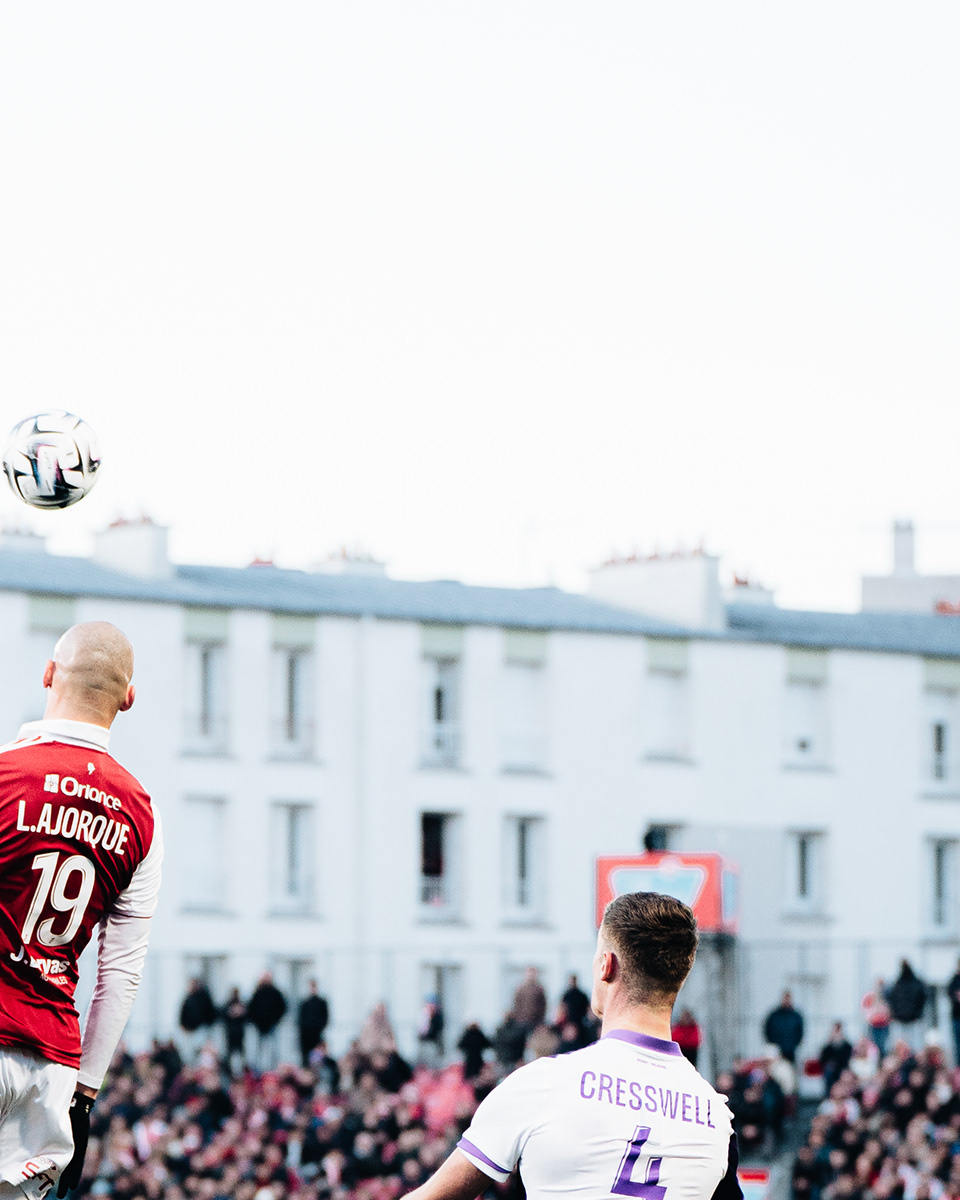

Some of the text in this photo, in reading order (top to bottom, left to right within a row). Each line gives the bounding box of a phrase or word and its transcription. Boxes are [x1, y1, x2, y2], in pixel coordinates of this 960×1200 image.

[60, 776, 122, 811] Oriance
[16, 800, 130, 855] L.AJORQUE
[21, 851, 96, 947] 19
[580, 1070, 716, 1129] CRESSWELL
